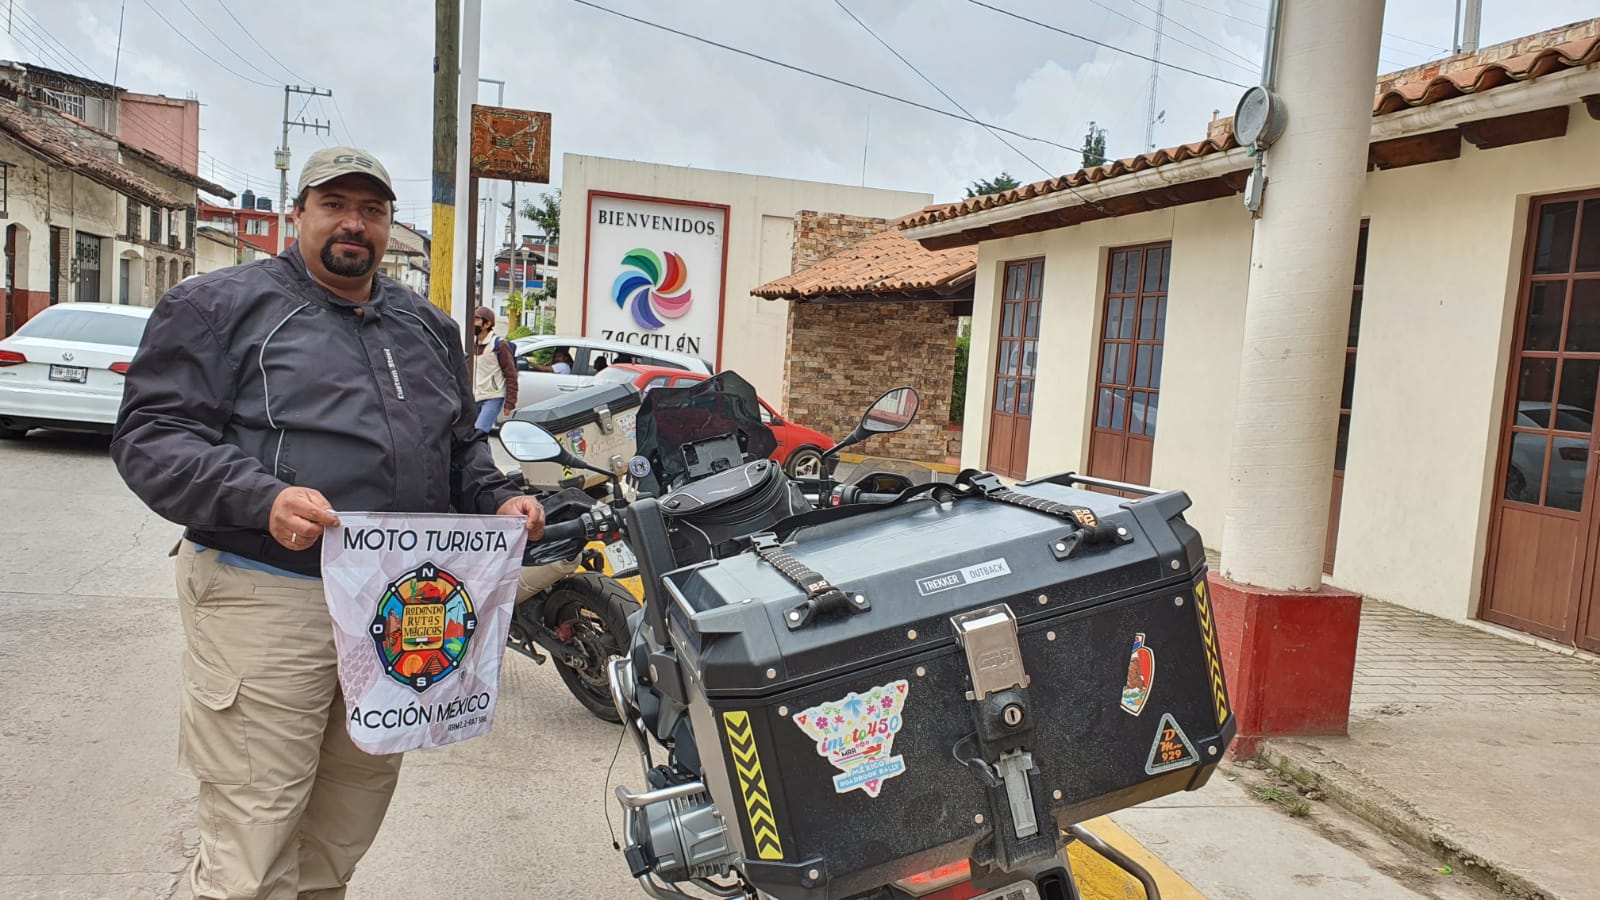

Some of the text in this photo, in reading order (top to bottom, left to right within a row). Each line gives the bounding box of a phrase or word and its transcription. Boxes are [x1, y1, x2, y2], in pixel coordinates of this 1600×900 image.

[333, 154, 373, 169] GS
[598, 209, 716, 236] BIENVENIDOS
[343, 526, 508, 552] MOTO TURISTA
[422, 568, 434, 577] N
[921, 563, 1005, 592] TREKKER OUTBACK
[467, 620, 475, 630] E
[416, 677, 427, 687] S
[350, 692, 490, 729] ACCIÓN MÉXICO
[1163, 728, 1177, 742] D
[1161, 749, 1183, 762] 929
